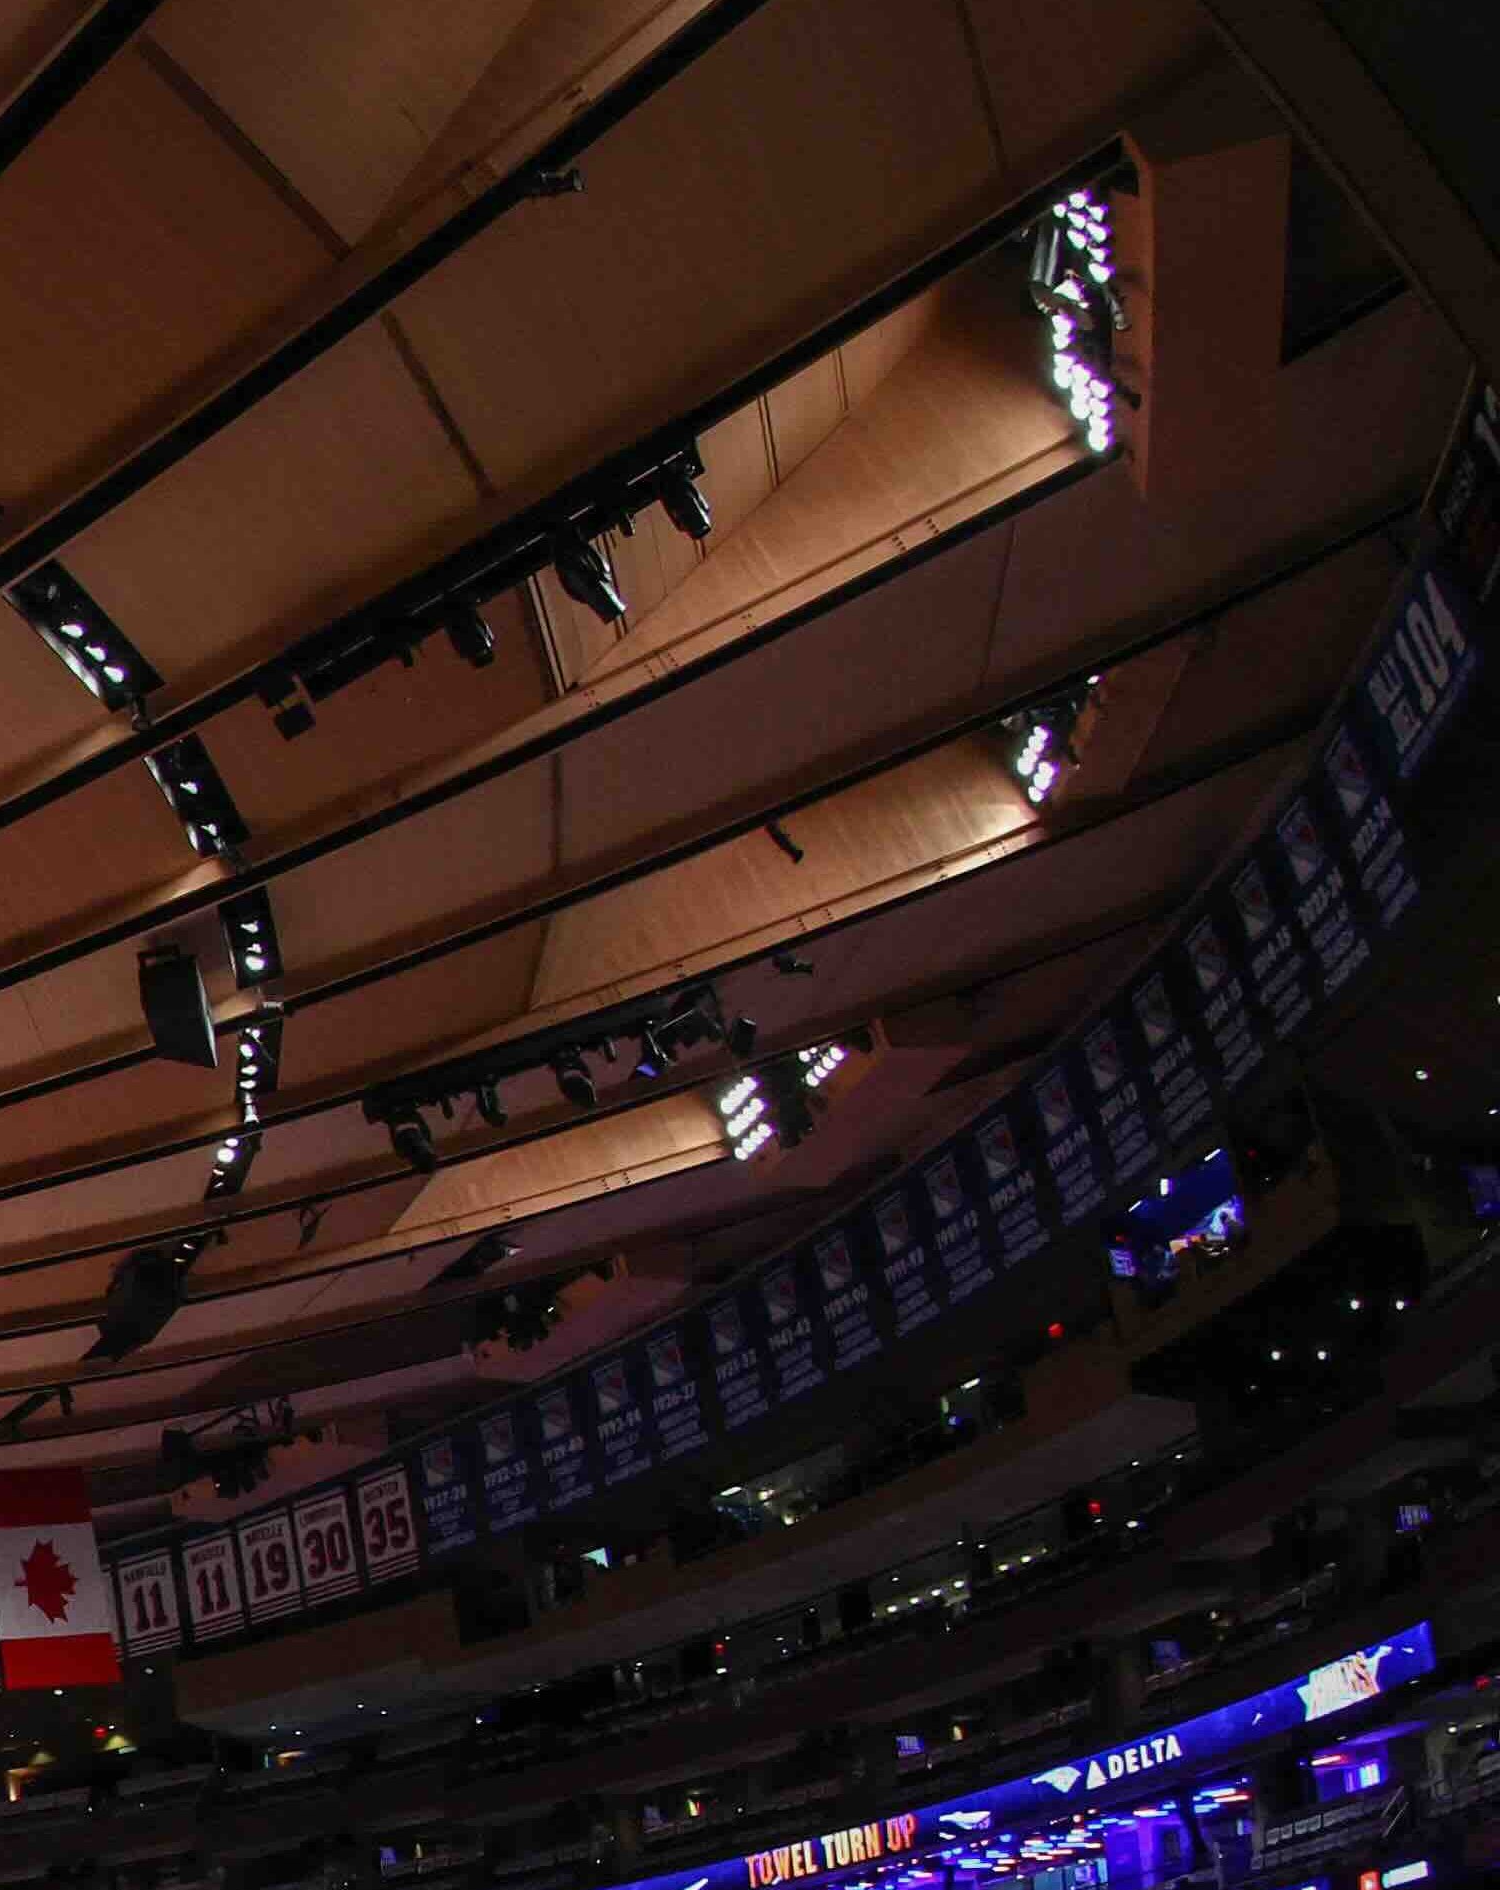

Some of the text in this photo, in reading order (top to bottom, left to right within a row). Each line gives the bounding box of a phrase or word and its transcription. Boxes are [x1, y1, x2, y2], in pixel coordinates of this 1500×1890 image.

[305, 1522, 347, 1578] 30
[365, 1499, 409, 1556] 35
[197, 1564, 230, 1615] 11
[251, 1543, 289, 1595] 19
[134, 1582, 168, 1631] 11
[1108, 1734, 1184, 1779] DELTA
[745, 1813, 916, 1889] TOWEL TURN UP
